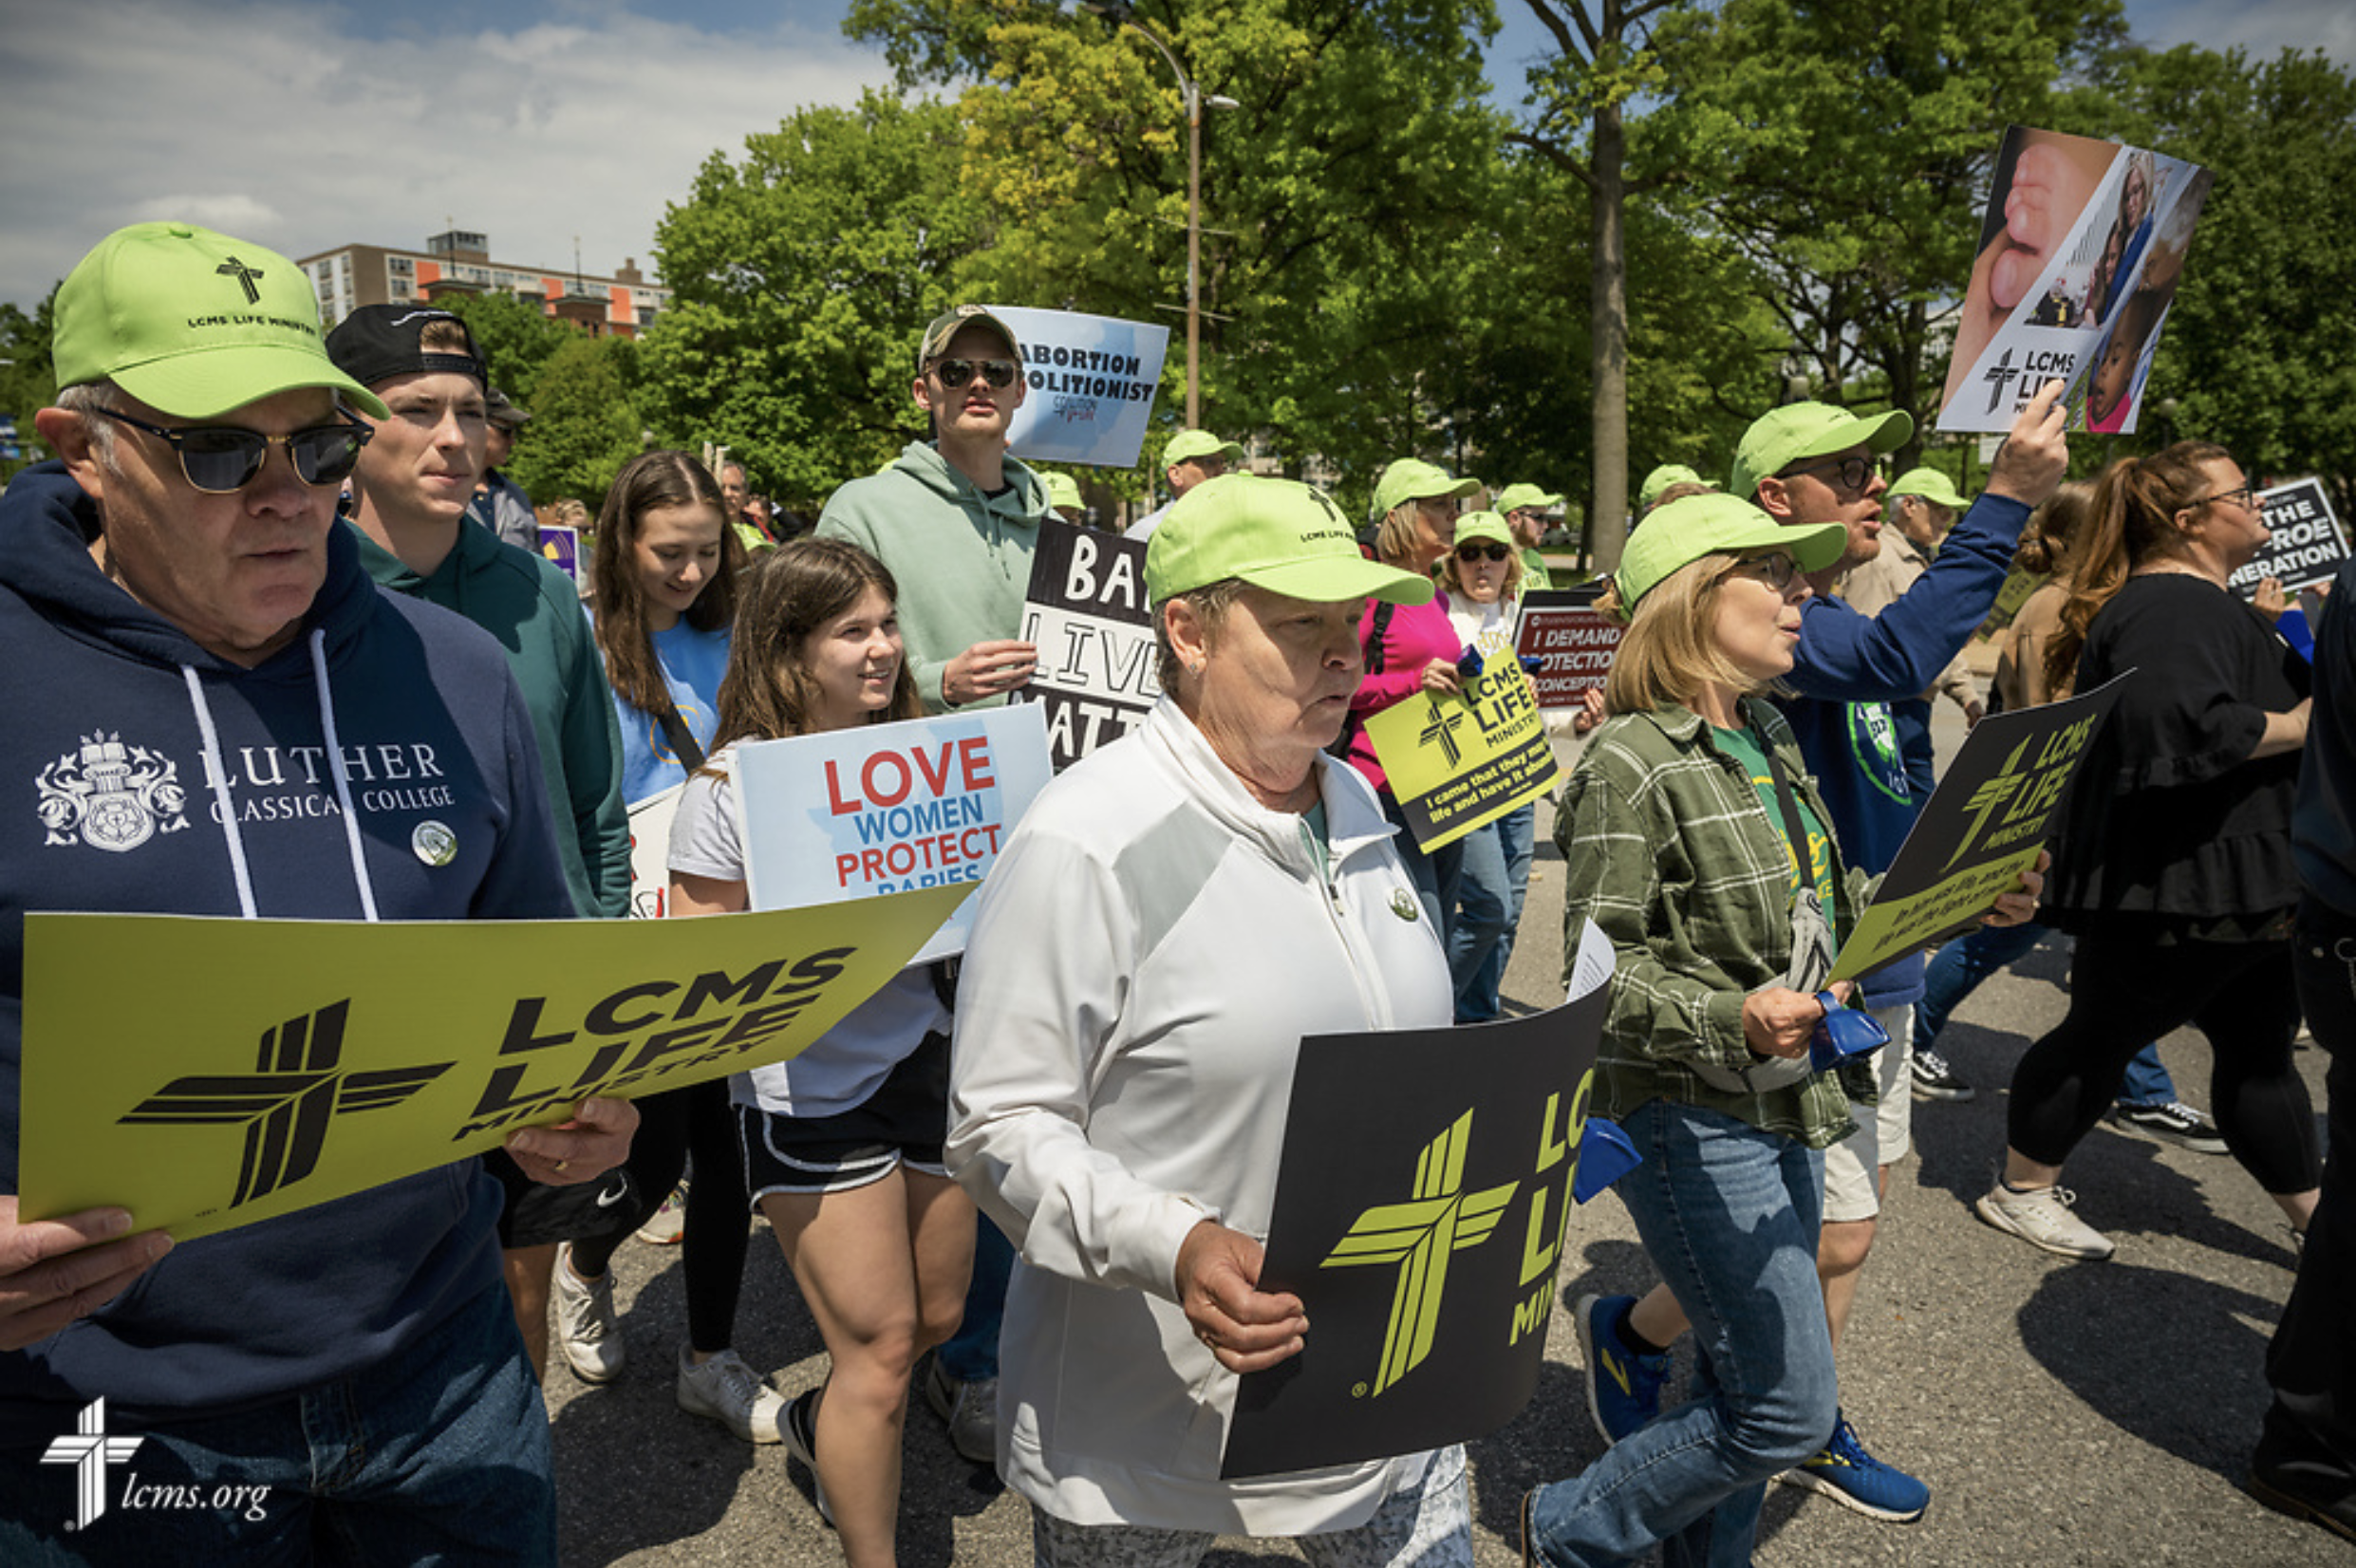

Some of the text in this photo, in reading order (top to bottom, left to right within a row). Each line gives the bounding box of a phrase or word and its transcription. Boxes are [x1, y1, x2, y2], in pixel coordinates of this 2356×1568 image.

[188, 315, 229, 328] LCMS
[233, 315, 265, 327] LIFE
[1028, 370, 1154, 401] OLITIONIST
[2025, 350, 2076, 373] LCMS
[2017, 375, 2068, 399] LI
[2261, 499, 2315, 528] THE
[1064, 534, 1150, 613] BA
[2227, 541, 2340, 587] NERATION
[1027, 613, 1164, 699] LIVE
[1524, 650, 1617, 672] OTECTIO
[1533, 630, 1542, 648] I
[1545, 626, 1622, 647] DEMAND
[1463, 662, 1521, 706] LCMS
[1472, 684, 1532, 733] LIFE
[1536, 675, 1608, 693] CONCEPTIO
[824, 736, 996, 816] LOVE
[2000, 758, 2077, 826] LIFE
[210, 784, 456, 823] CASSICA COLLEGE
[853, 793, 984, 845] WOMEN
[835, 823, 1001, 887] PROTECT
[499, 946, 858, 1055] LCMS
[469, 993, 822, 1119] LIFE
[452, 1036, 776, 1142] MINISTRY
[1536, 1067, 1595, 1173] LC
[1519, 1160, 1577, 1286] LI
